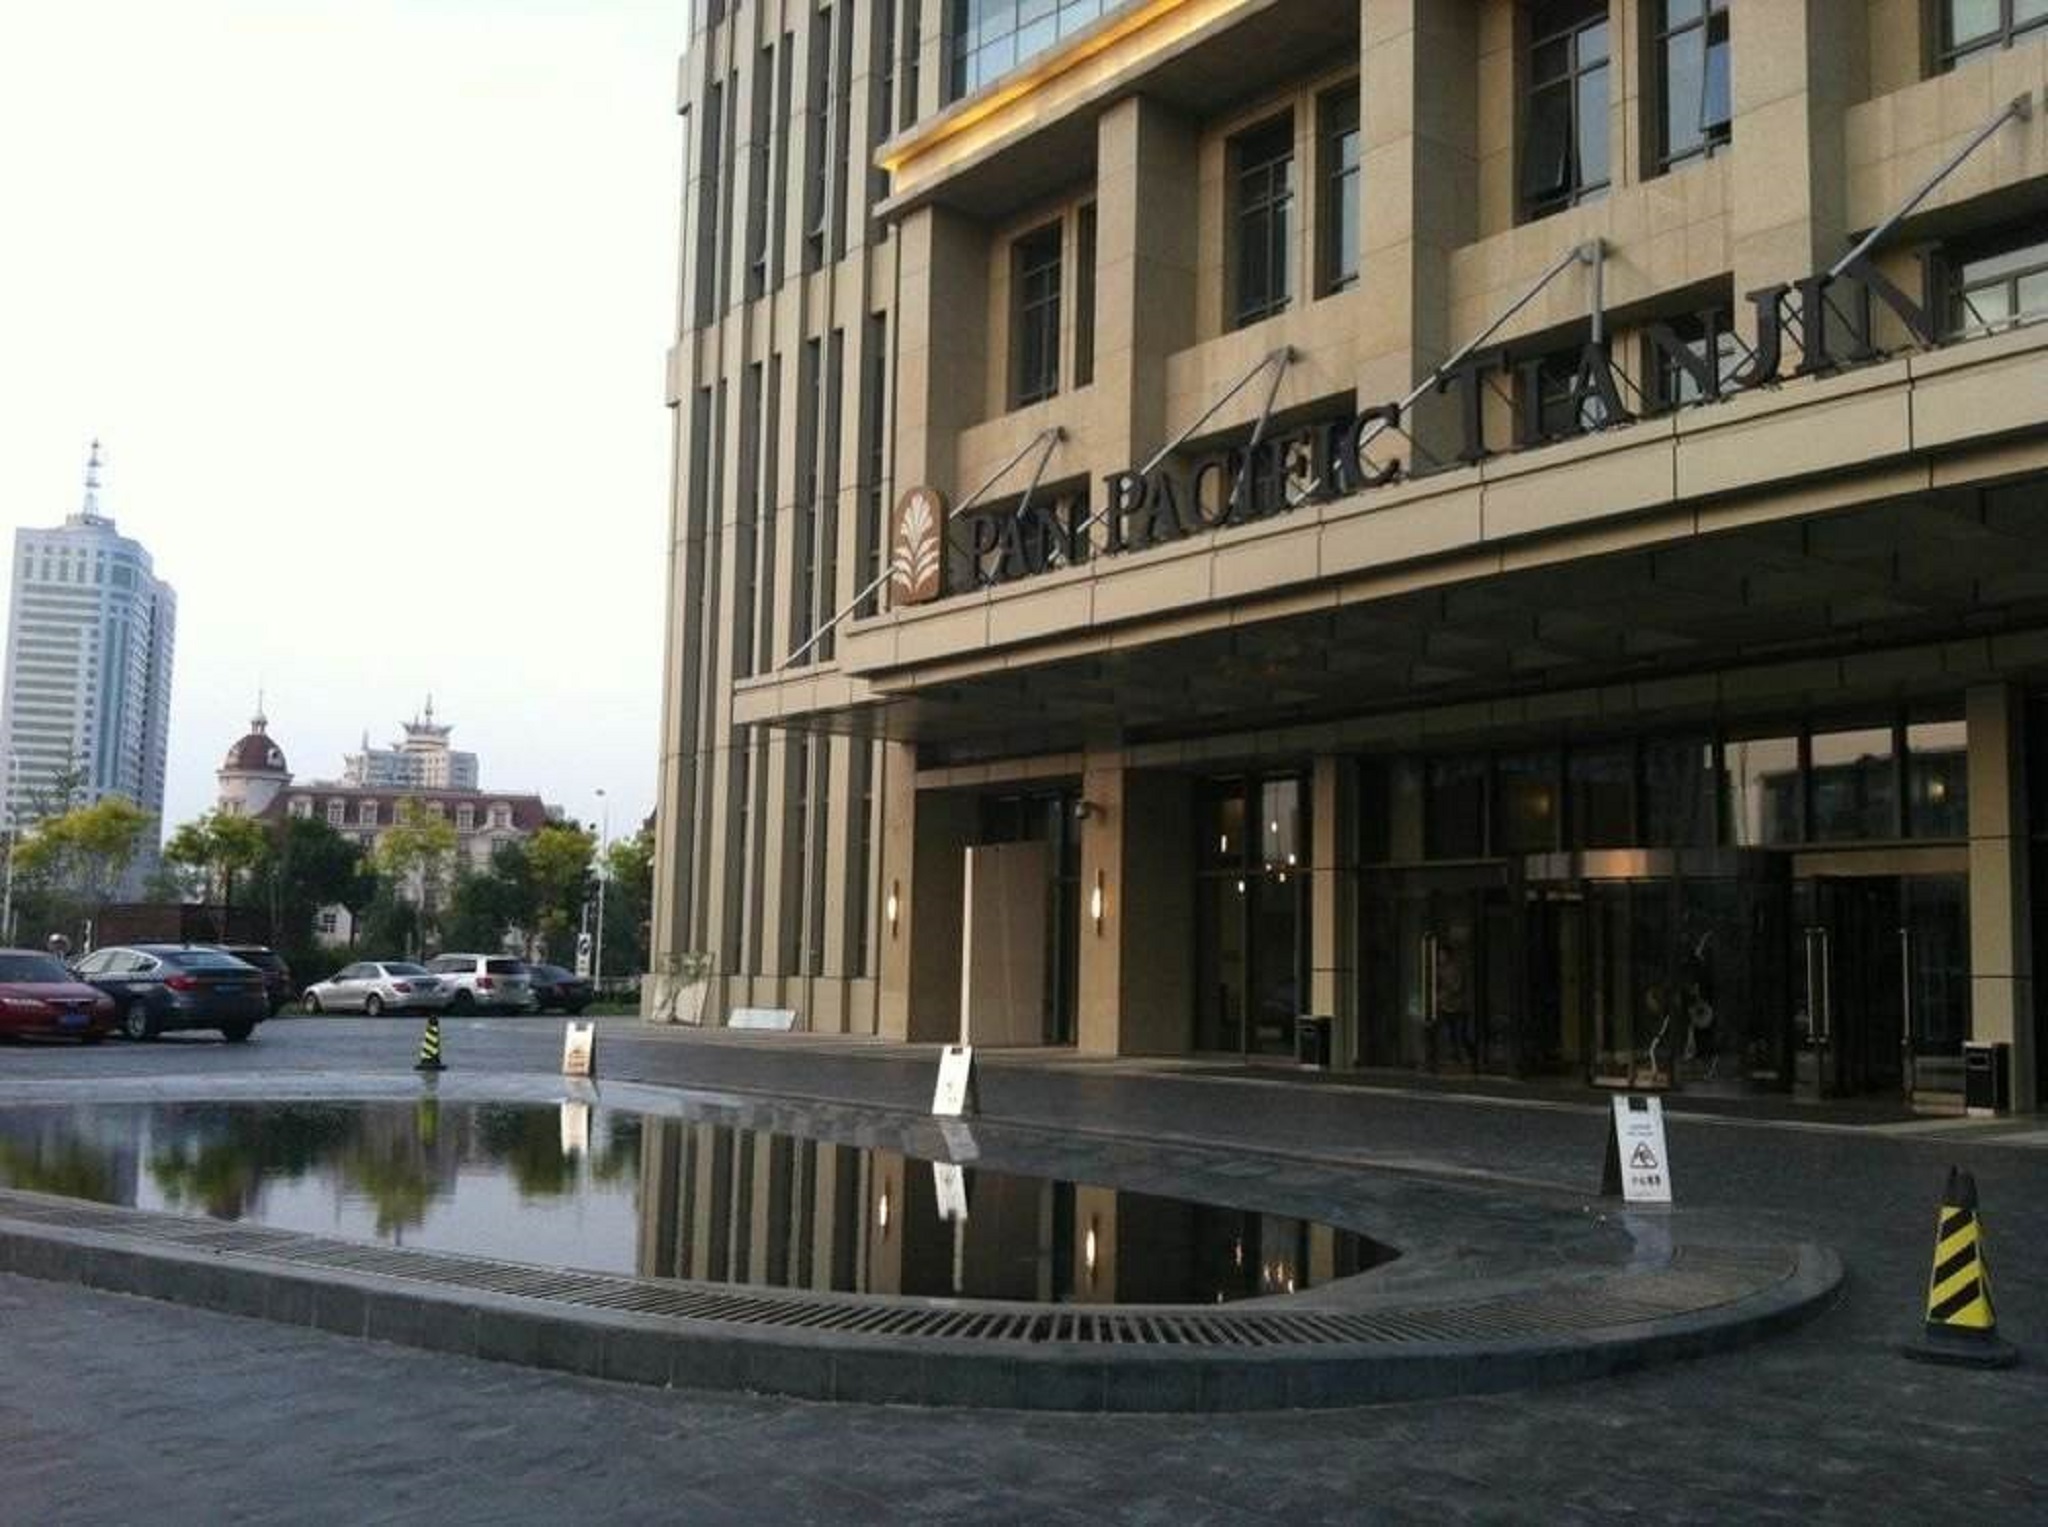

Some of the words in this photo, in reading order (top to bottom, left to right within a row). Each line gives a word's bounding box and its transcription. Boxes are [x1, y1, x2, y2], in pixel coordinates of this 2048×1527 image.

[968, 498, 1082, 584] PAN
[1104, 403, 1402, 555] PACIFIC
[1438, 242, 1947, 461] TIANJIN
